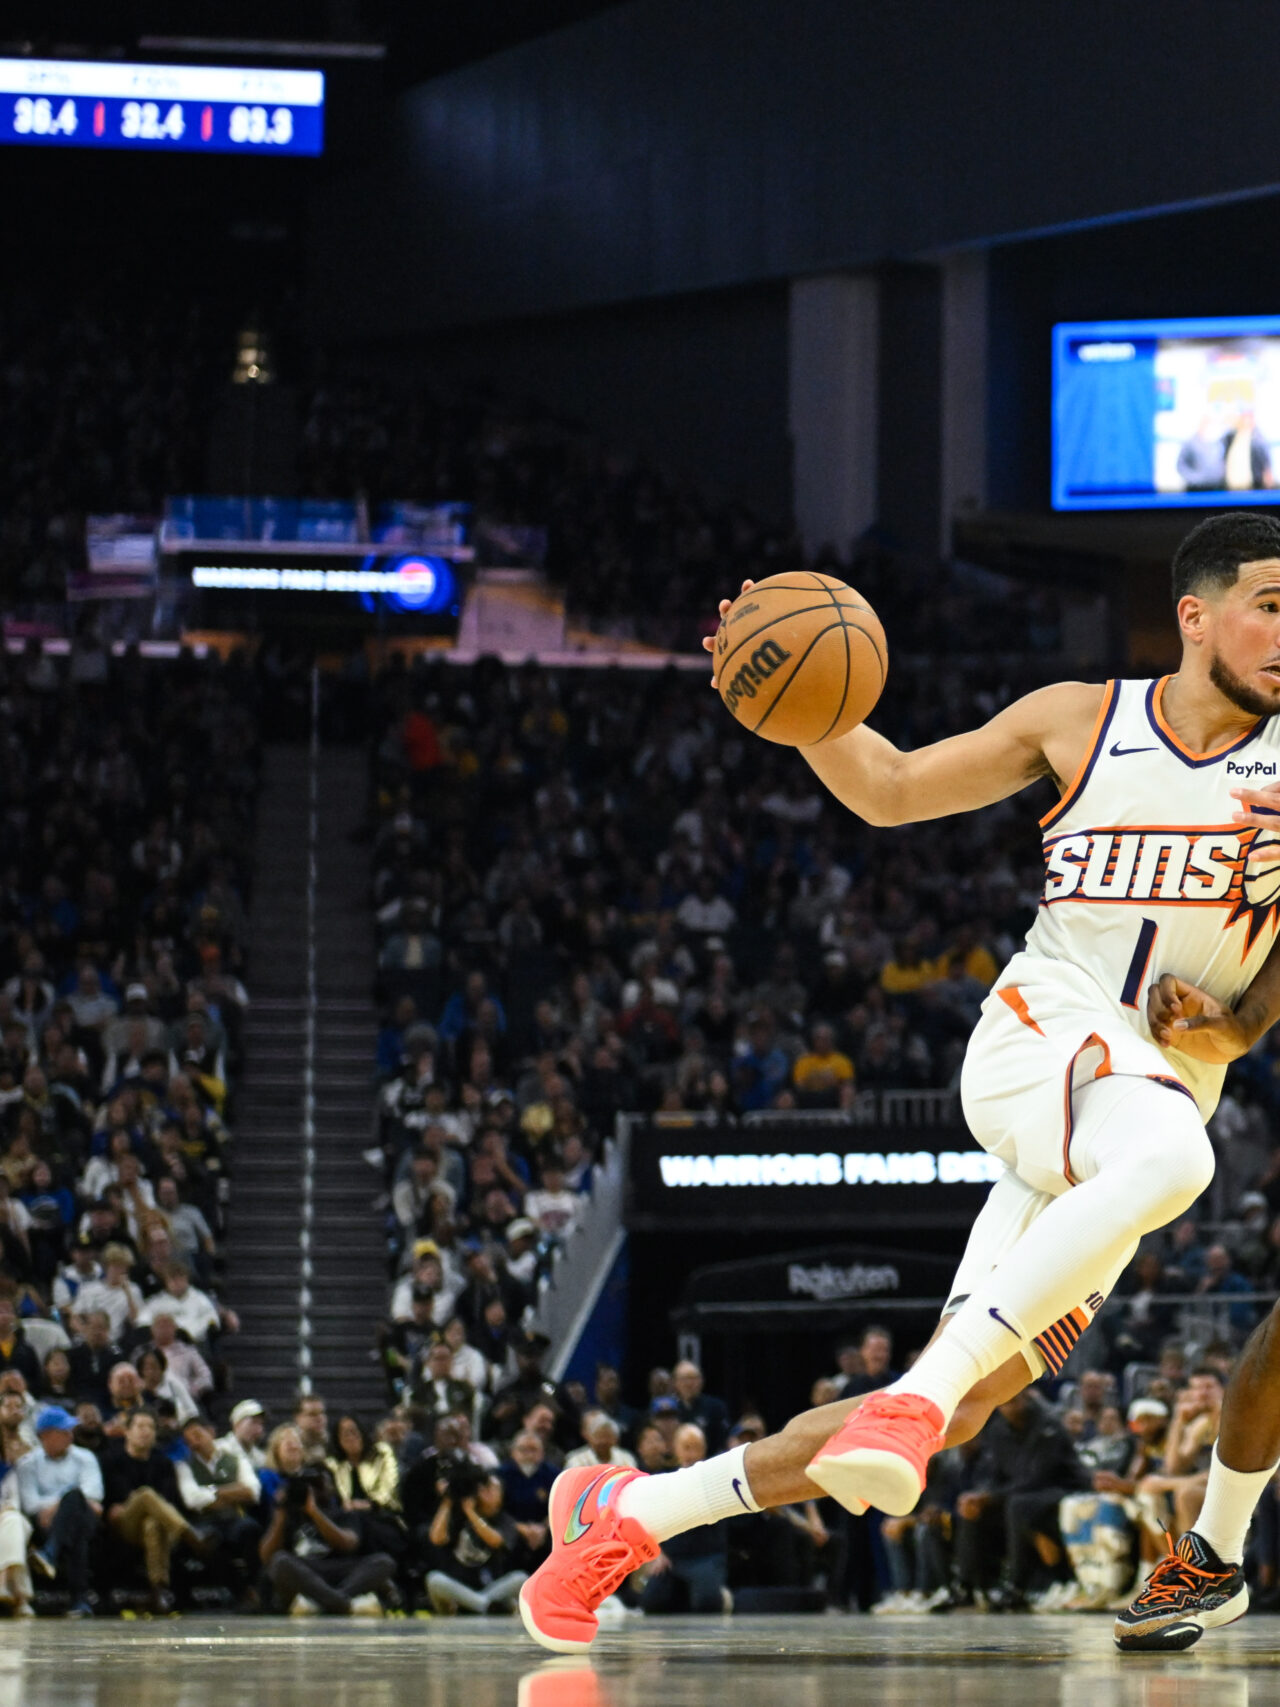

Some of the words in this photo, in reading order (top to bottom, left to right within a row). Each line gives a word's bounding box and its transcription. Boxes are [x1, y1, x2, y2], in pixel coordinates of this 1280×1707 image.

[1226, 760, 1276, 779] PayPal
[1045, 834, 1241, 900] SUNS
[1119, 917, 1159, 1011] 1
[659, 1153, 842, 1187] WARRIORS
[844, 1152, 937, 1184] FANS
[787, 1262, 899, 1300] Rakuten
